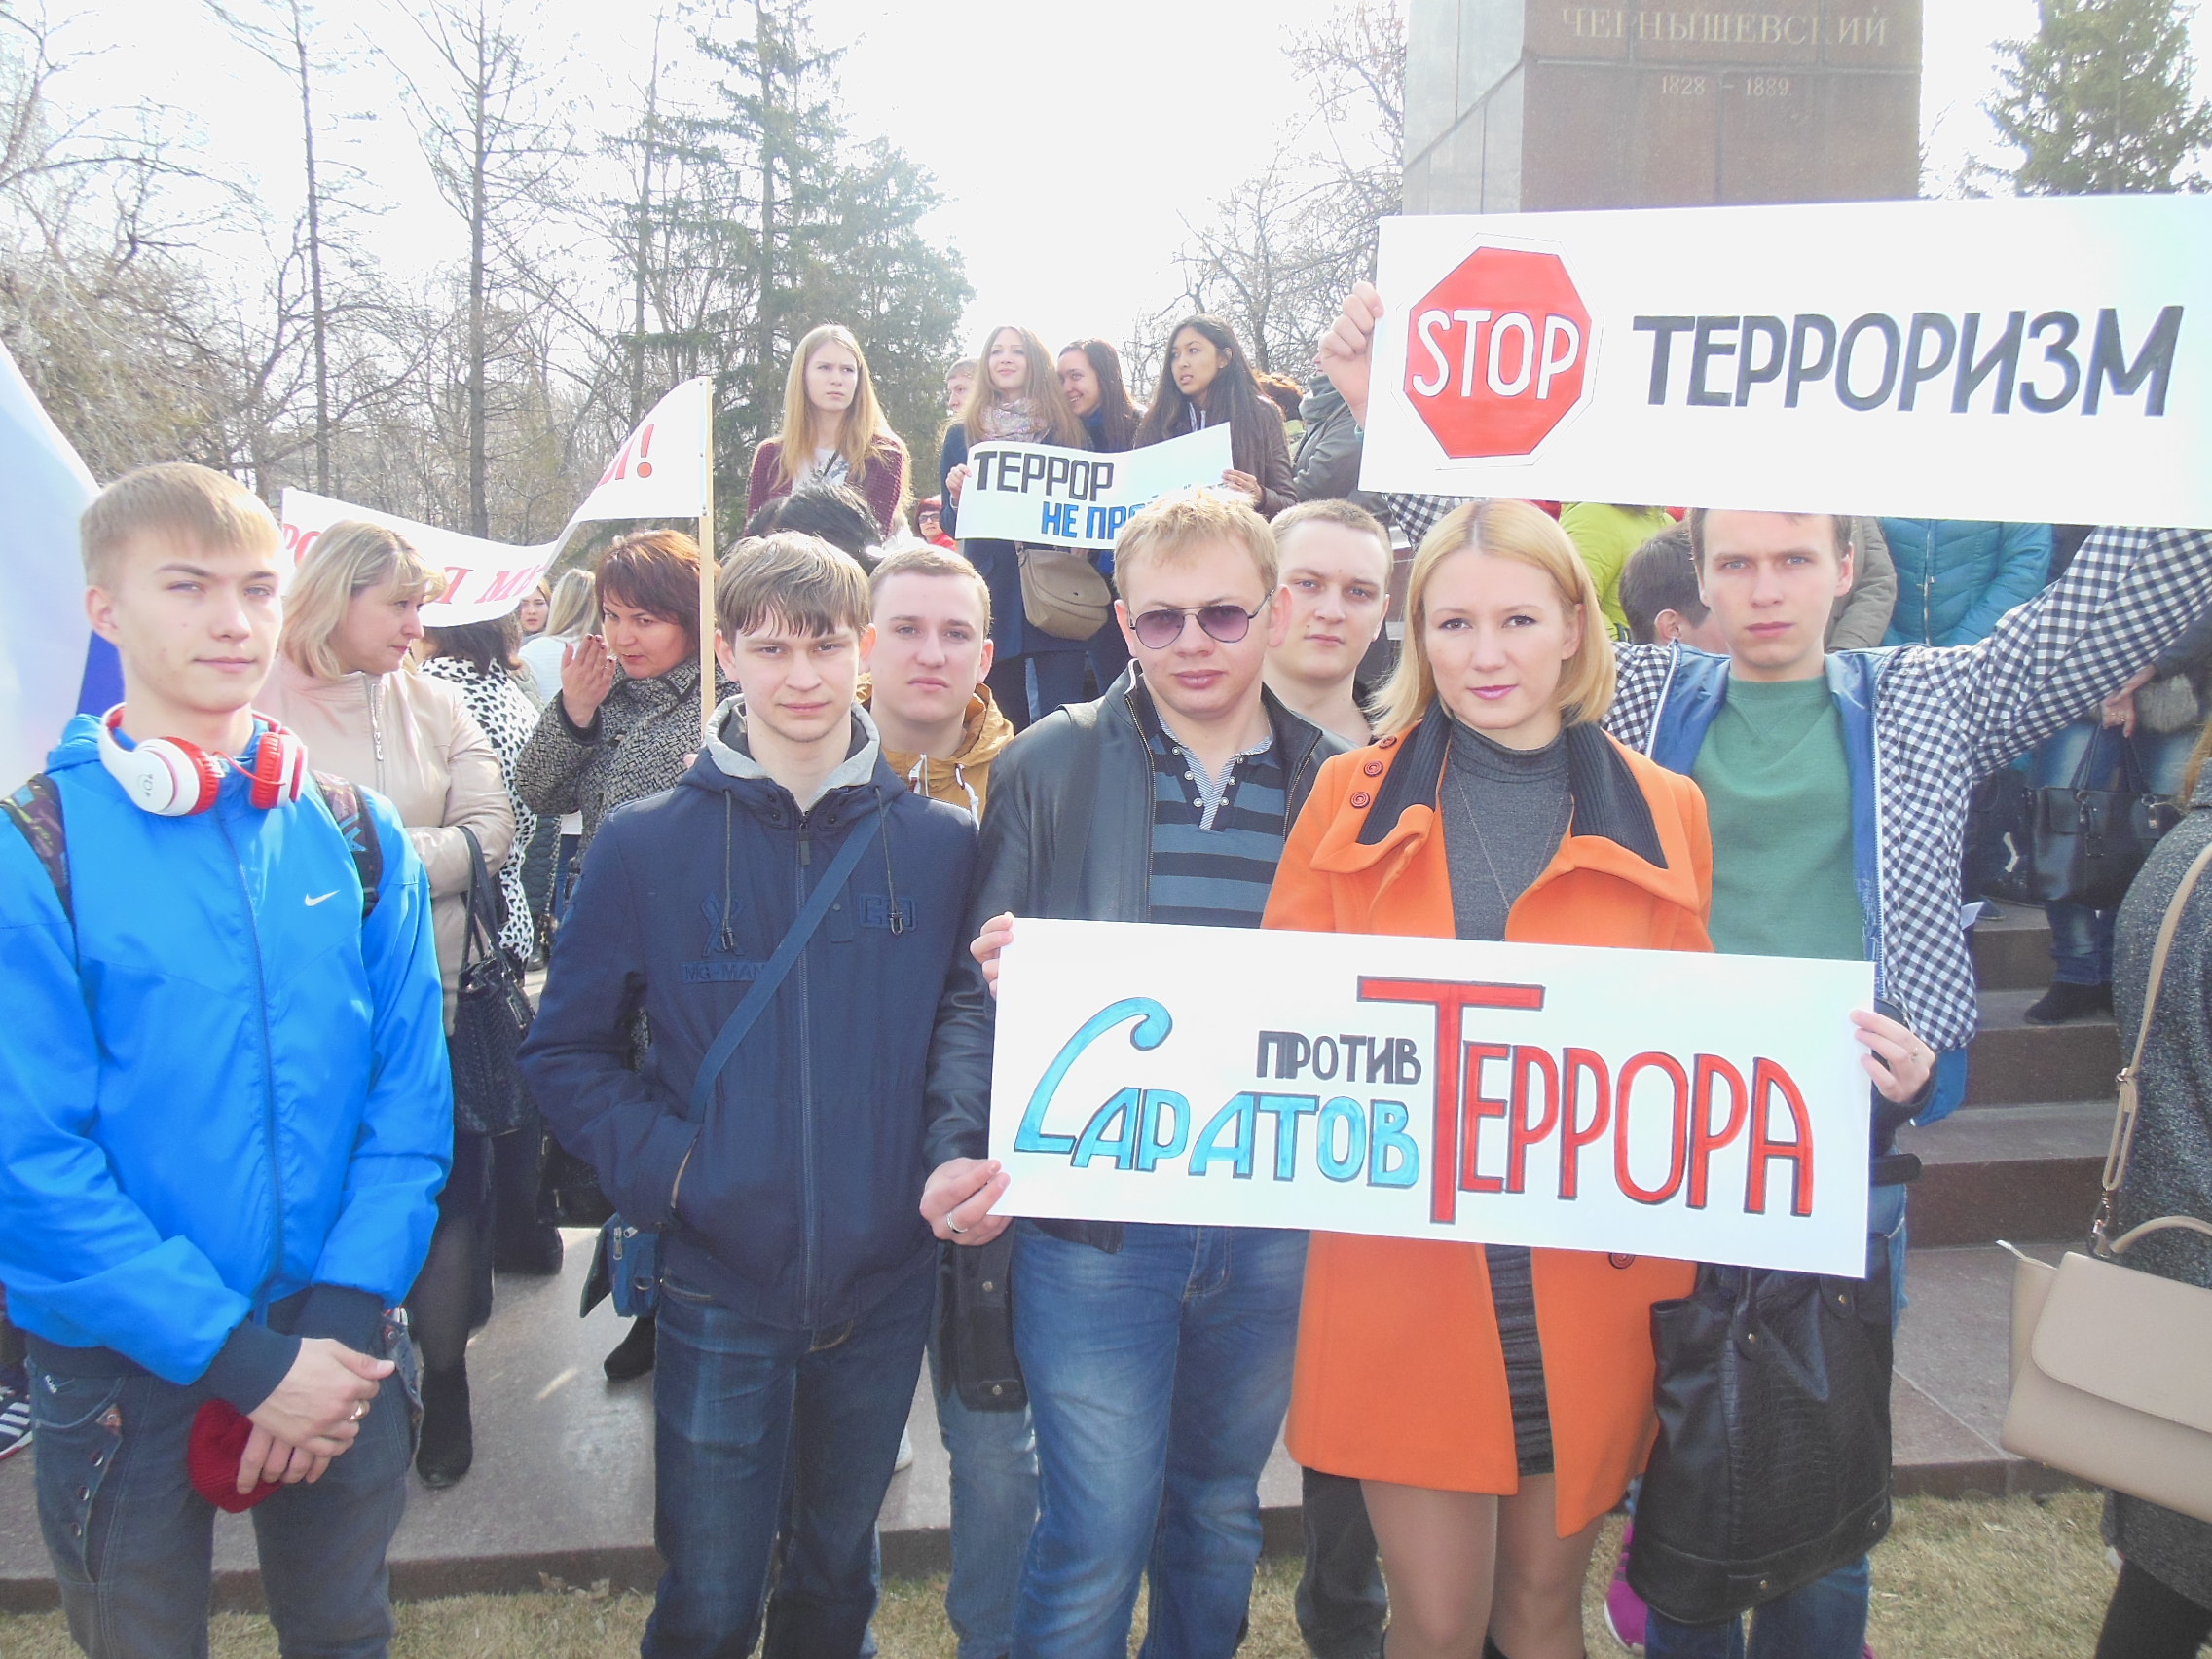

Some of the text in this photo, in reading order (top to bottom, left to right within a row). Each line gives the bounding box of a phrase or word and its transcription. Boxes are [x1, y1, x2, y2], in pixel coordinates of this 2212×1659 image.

[1563, 6, 1889, 46] ЧЕРНЫШЕВСКИЙ
[1661, 75, 1706, 95] 1828
[1412, 309, 1581, 401] STOP
[1632, 305, 2185, 418] ТЕРРОРИЗМ
[974, 450, 1114, 502] ТЕРРОР
[1041, 501, 1079, 538] НЕ
[1256, 1029, 1422, 1086] ПРОТИВ
[1014, 996, 1420, 1189] САРАТОВ
[1357, 976, 1814, 1224] ТЕРРОРА
